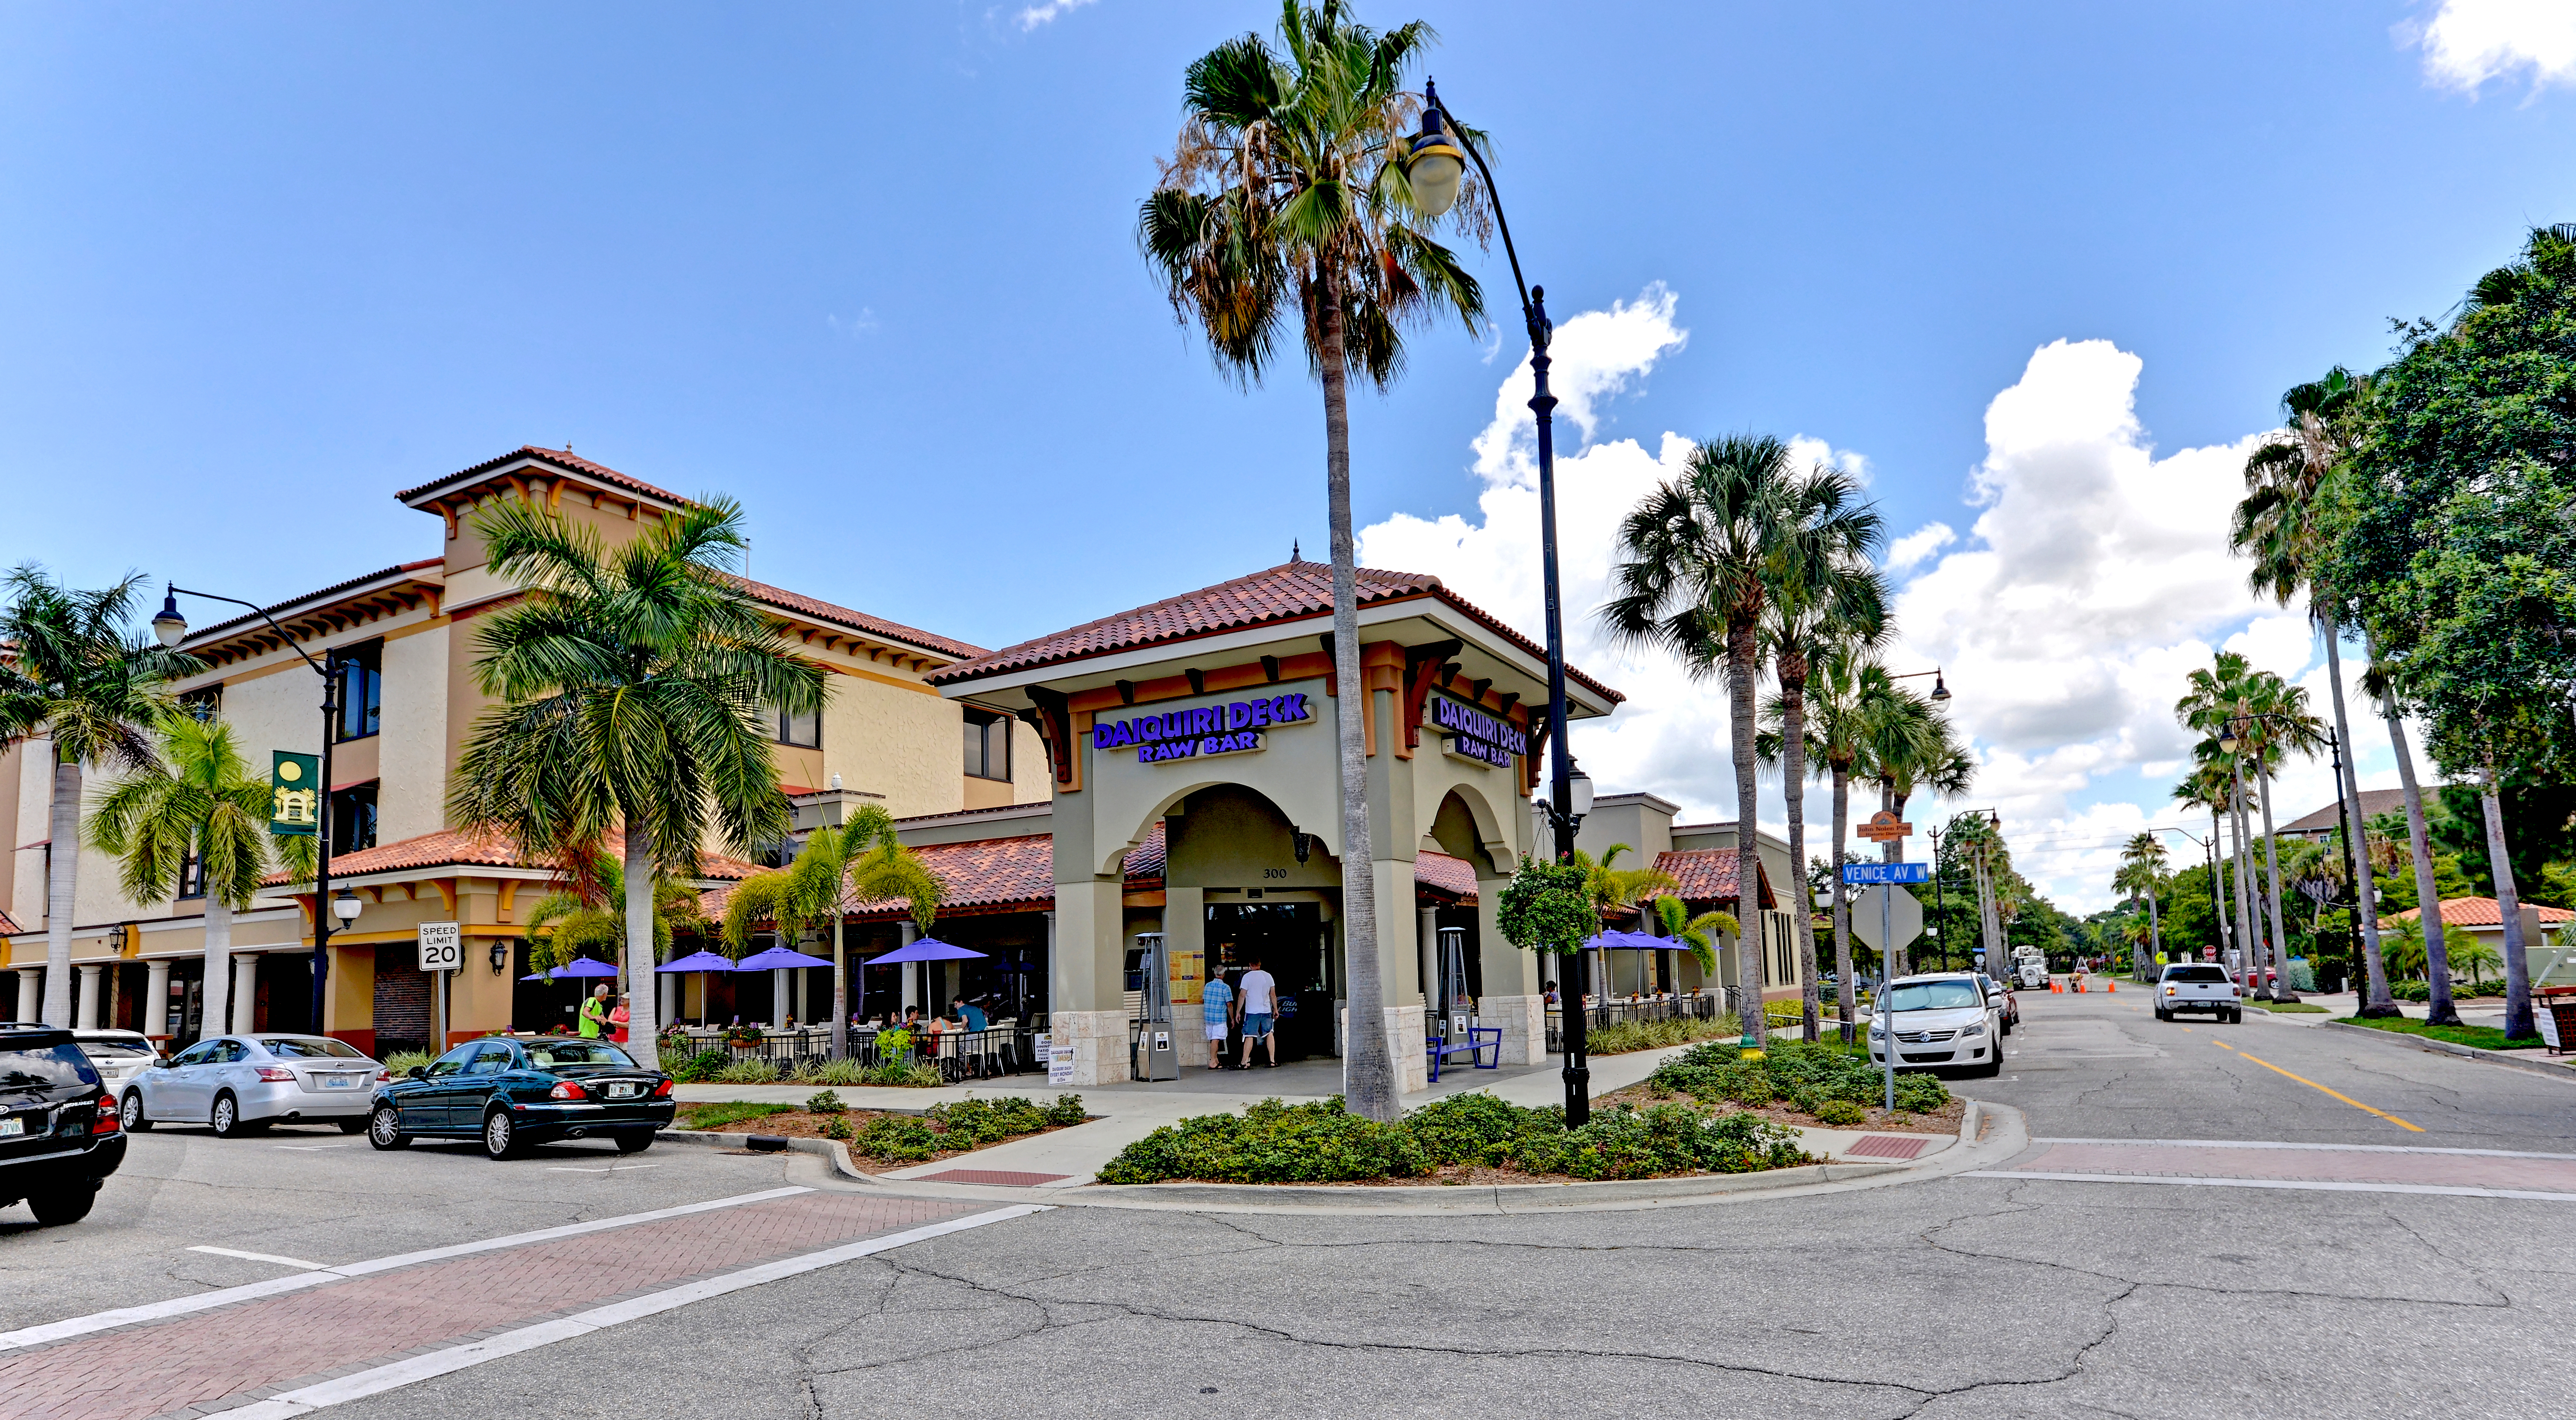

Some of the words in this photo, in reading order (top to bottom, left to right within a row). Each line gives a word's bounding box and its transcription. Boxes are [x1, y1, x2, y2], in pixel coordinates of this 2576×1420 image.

[1094, 705, 1224, 749] DAIQUIRI
[1229, 693, 1309, 729] DECK
[1440, 697, 1497, 744] DAIQUIRI
[1499, 723, 1527, 755] DECK
[1138, 739, 1199, 762] RAW
[1204, 731, 1259, 754] BAR
[1462, 736, 1487, 759] RAW
[1491, 747, 1511, 768] BAR
[1264, 869, 1287, 878] 300
[1845, 866, 1887, 881] VENICE
[1894, 866, 1909, 880] AV
[1915, 865, 1926, 879] W
[425, 946, 456, 964] 20
